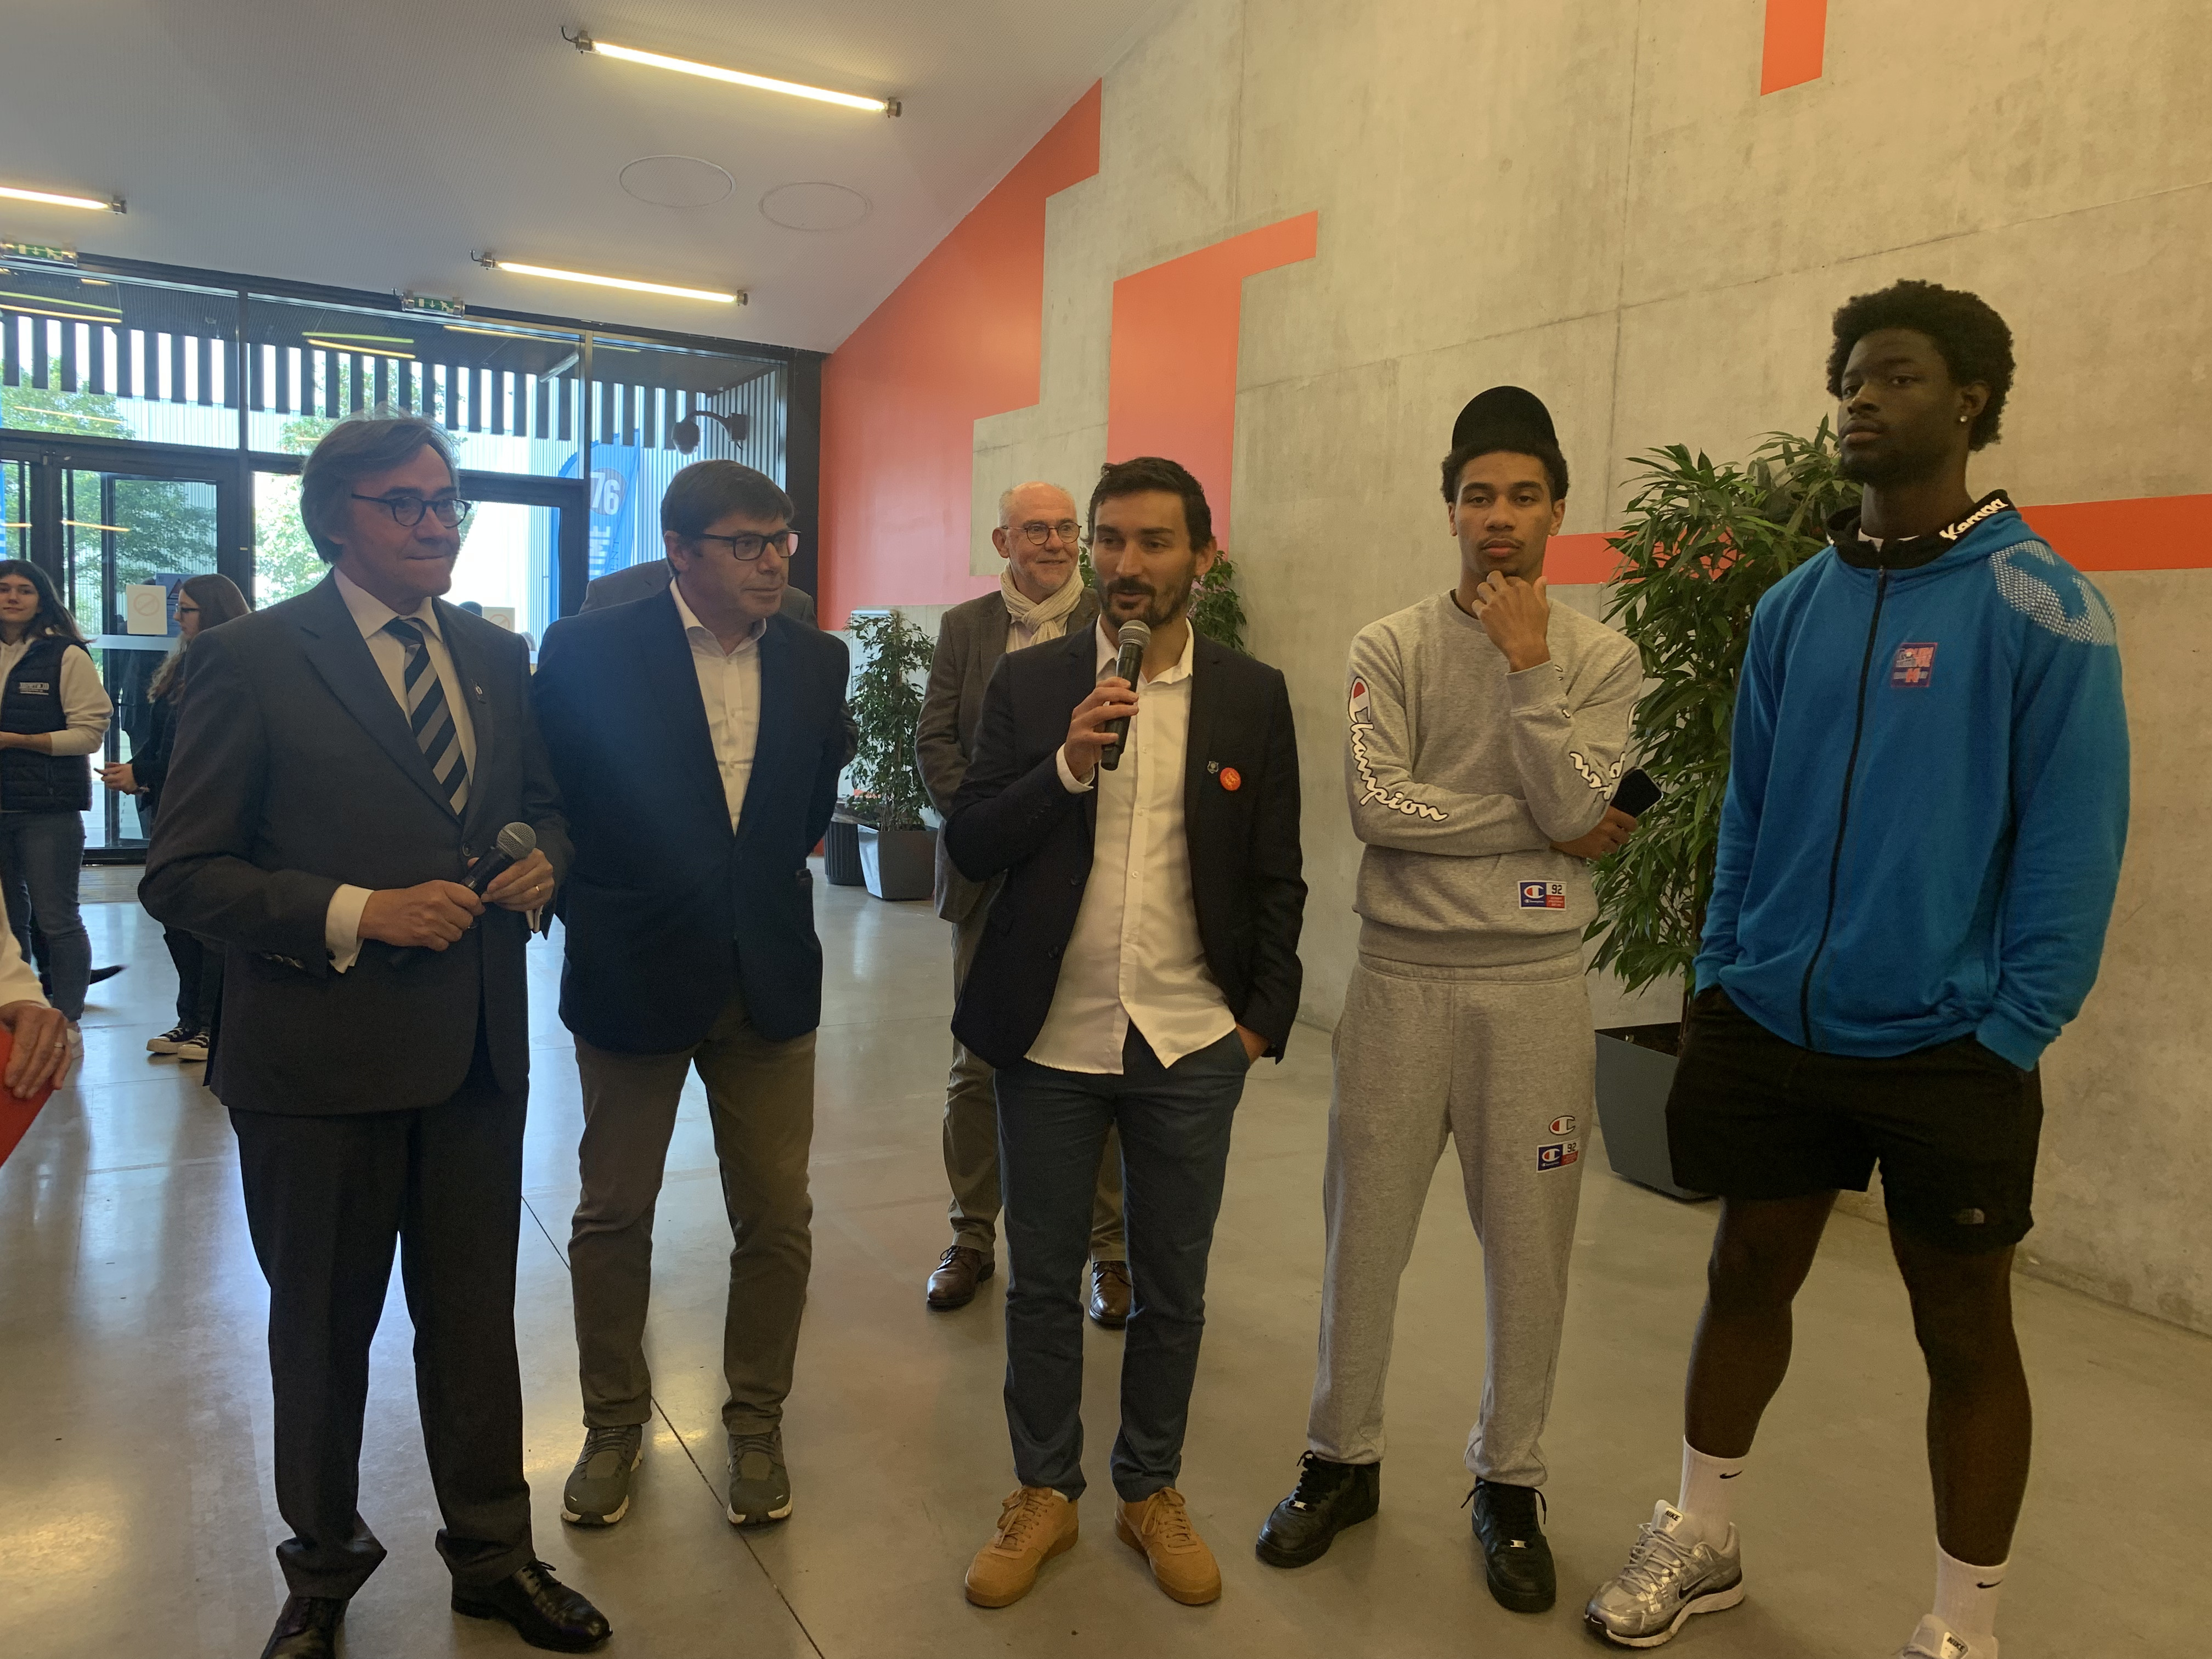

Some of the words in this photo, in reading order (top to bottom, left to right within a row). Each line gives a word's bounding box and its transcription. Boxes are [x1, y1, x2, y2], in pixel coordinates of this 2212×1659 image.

[590, 472, 620, 515] 76
[1348, 676, 1449, 821] Champion
[1551, 884, 1562, 894] 92
[1567, 1142, 1577, 1153] 92
[1664, 1510, 1681, 1521] NIKE
[1946, 1637, 1966, 1652] NIKE
